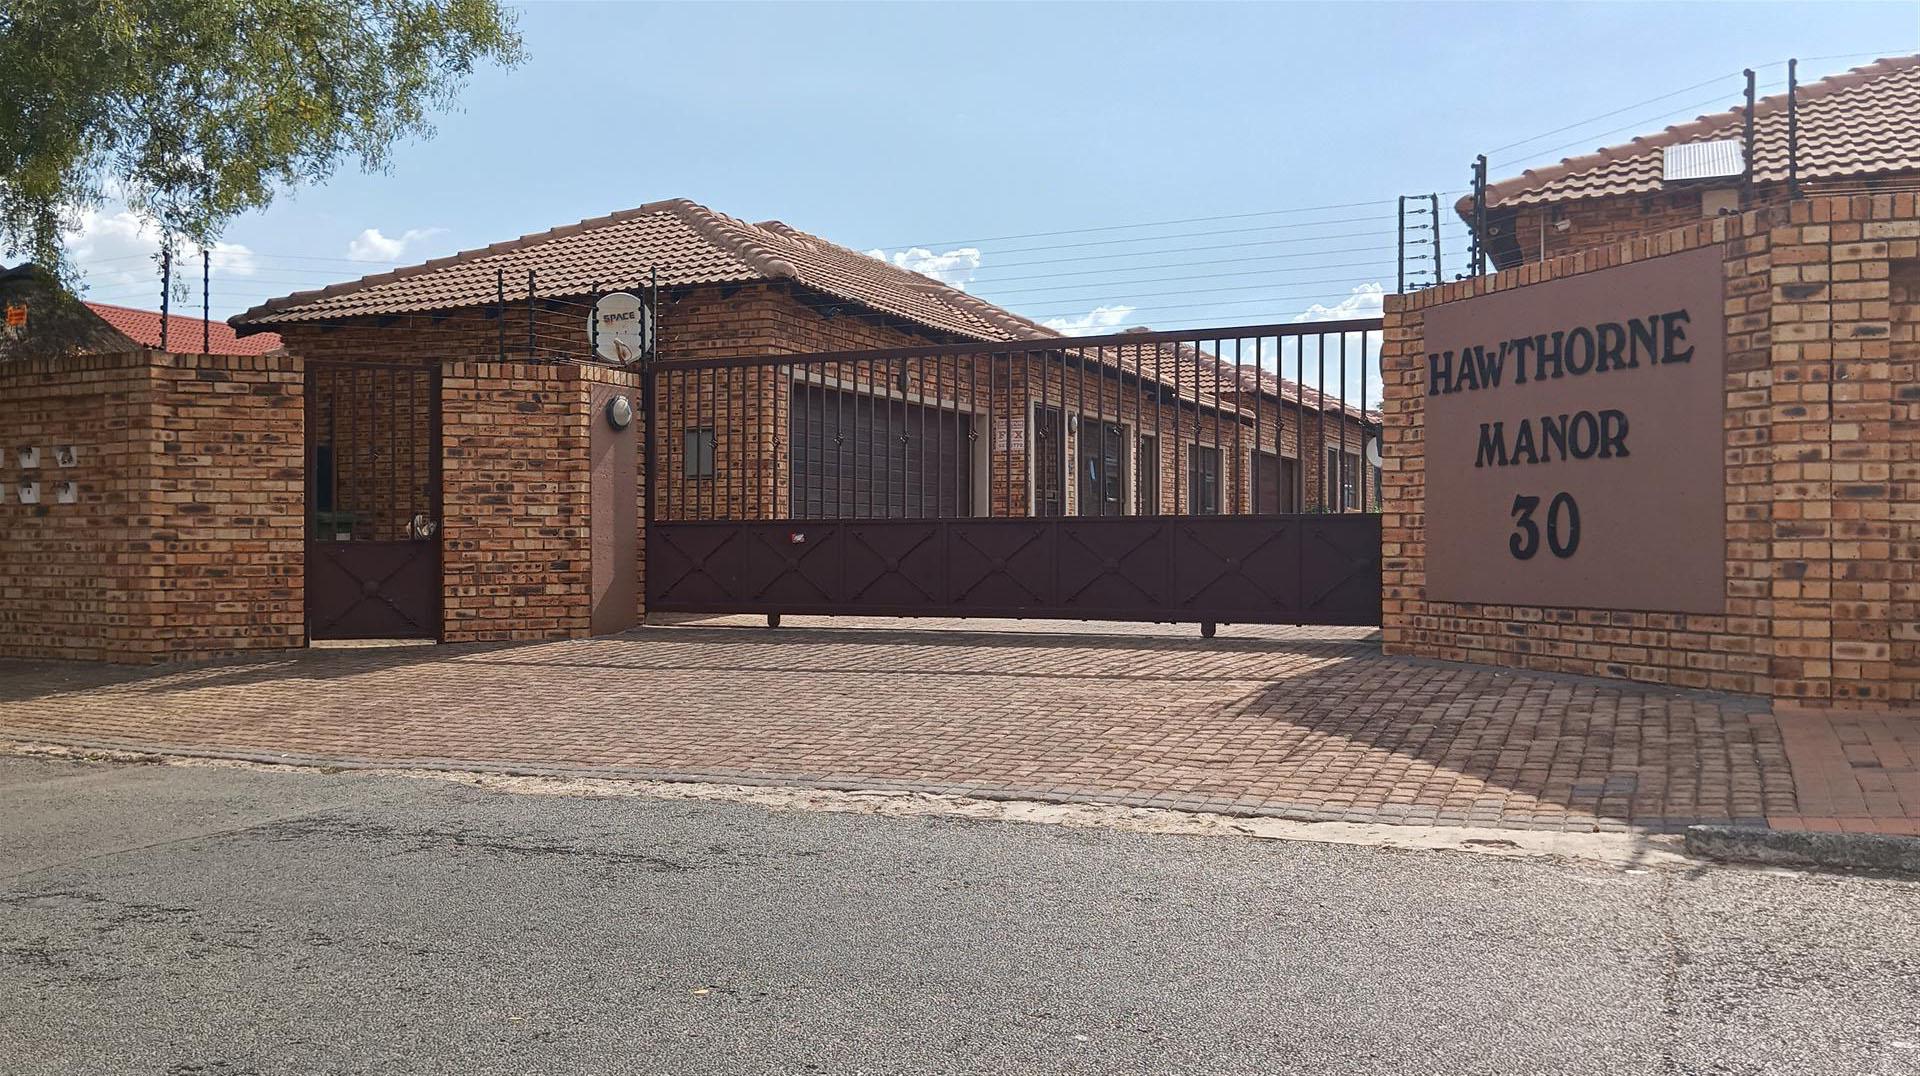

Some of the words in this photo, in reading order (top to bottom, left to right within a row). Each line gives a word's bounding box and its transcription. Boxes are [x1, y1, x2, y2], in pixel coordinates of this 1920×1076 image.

[603, 311, 635, 322] SPACE
[1428, 309, 1695, 396] HAWTHORNE
[998, 430, 1023, 439] FX
[1474, 409, 1630, 468] MANOR
[1509, 491, 1581, 561] 30
